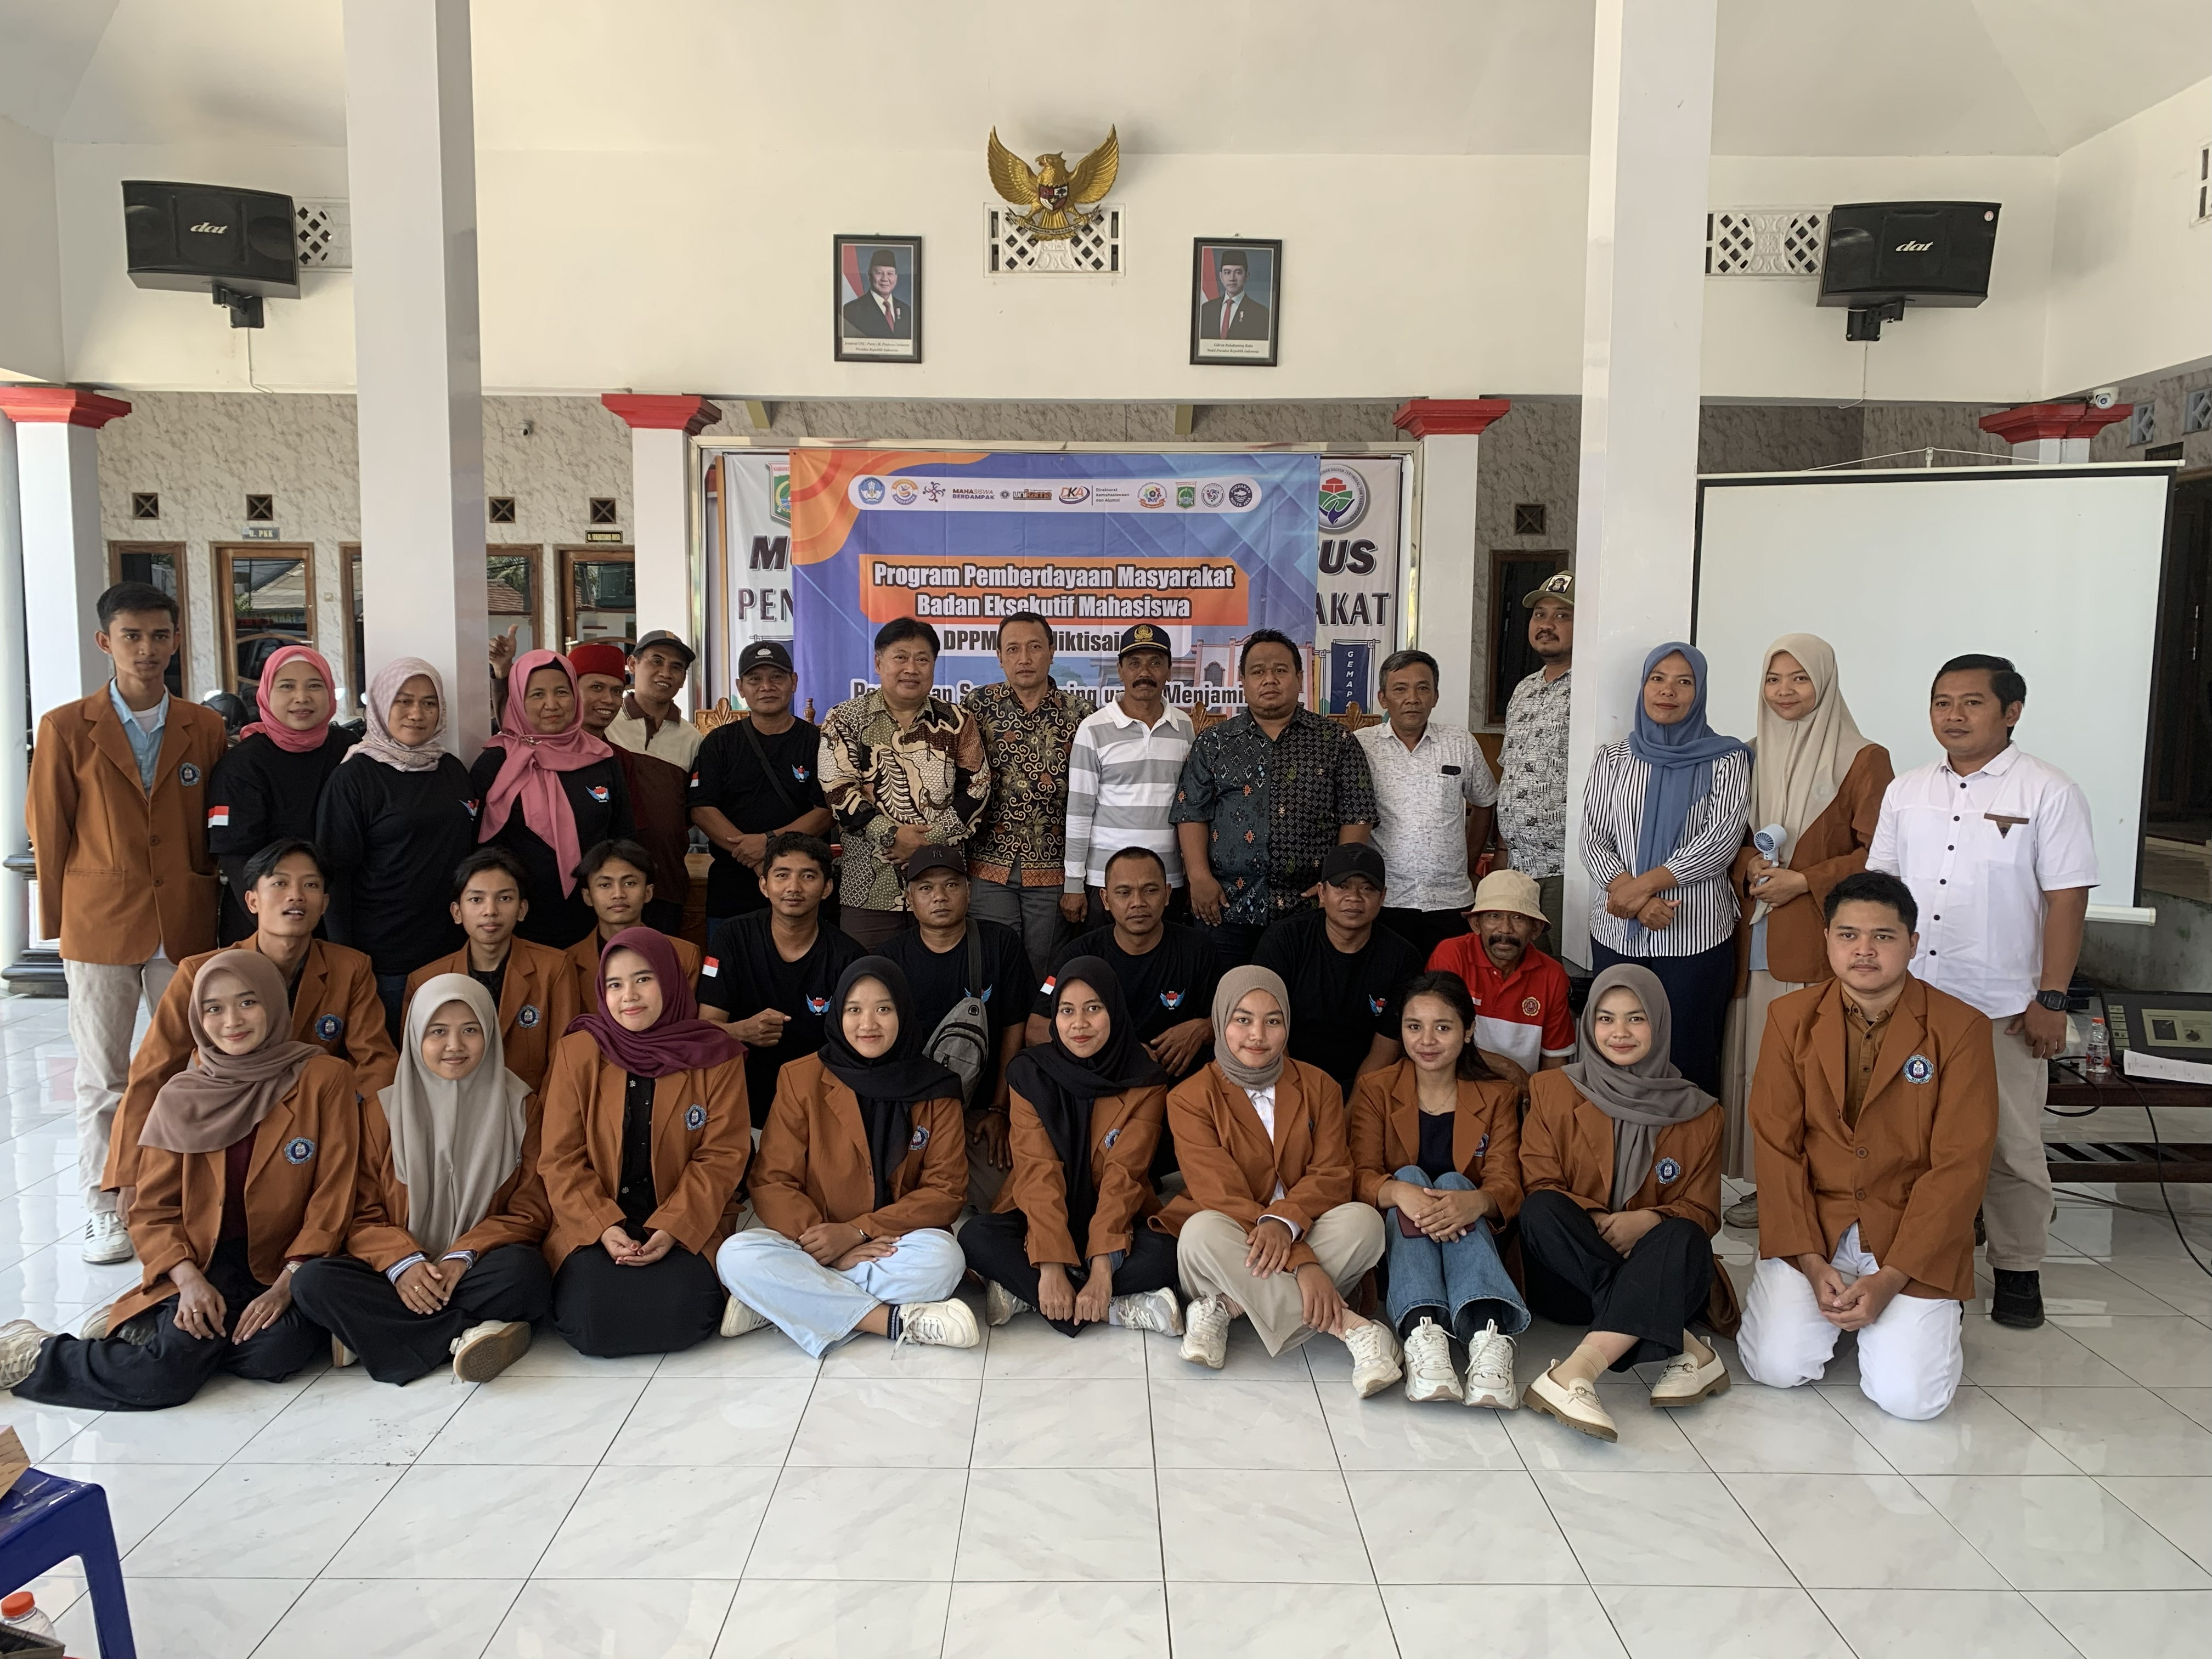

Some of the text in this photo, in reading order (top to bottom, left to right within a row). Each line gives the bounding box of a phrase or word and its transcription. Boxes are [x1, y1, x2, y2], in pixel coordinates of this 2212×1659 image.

[1060, 487, 1085, 498] DKA
[1230, 484, 1251, 494] POKDAKAN
[749, 535, 792, 571] M
[1318, 539, 1377, 575] US
[873, 563, 1234, 589] Program Pemberdayaan Masyarakat
[916, 594, 1190, 617] Badan Eksekutif Mahasiswa
[943, 630, 997, 651] DPPM
[1164, 684, 1246, 708] Menjami
